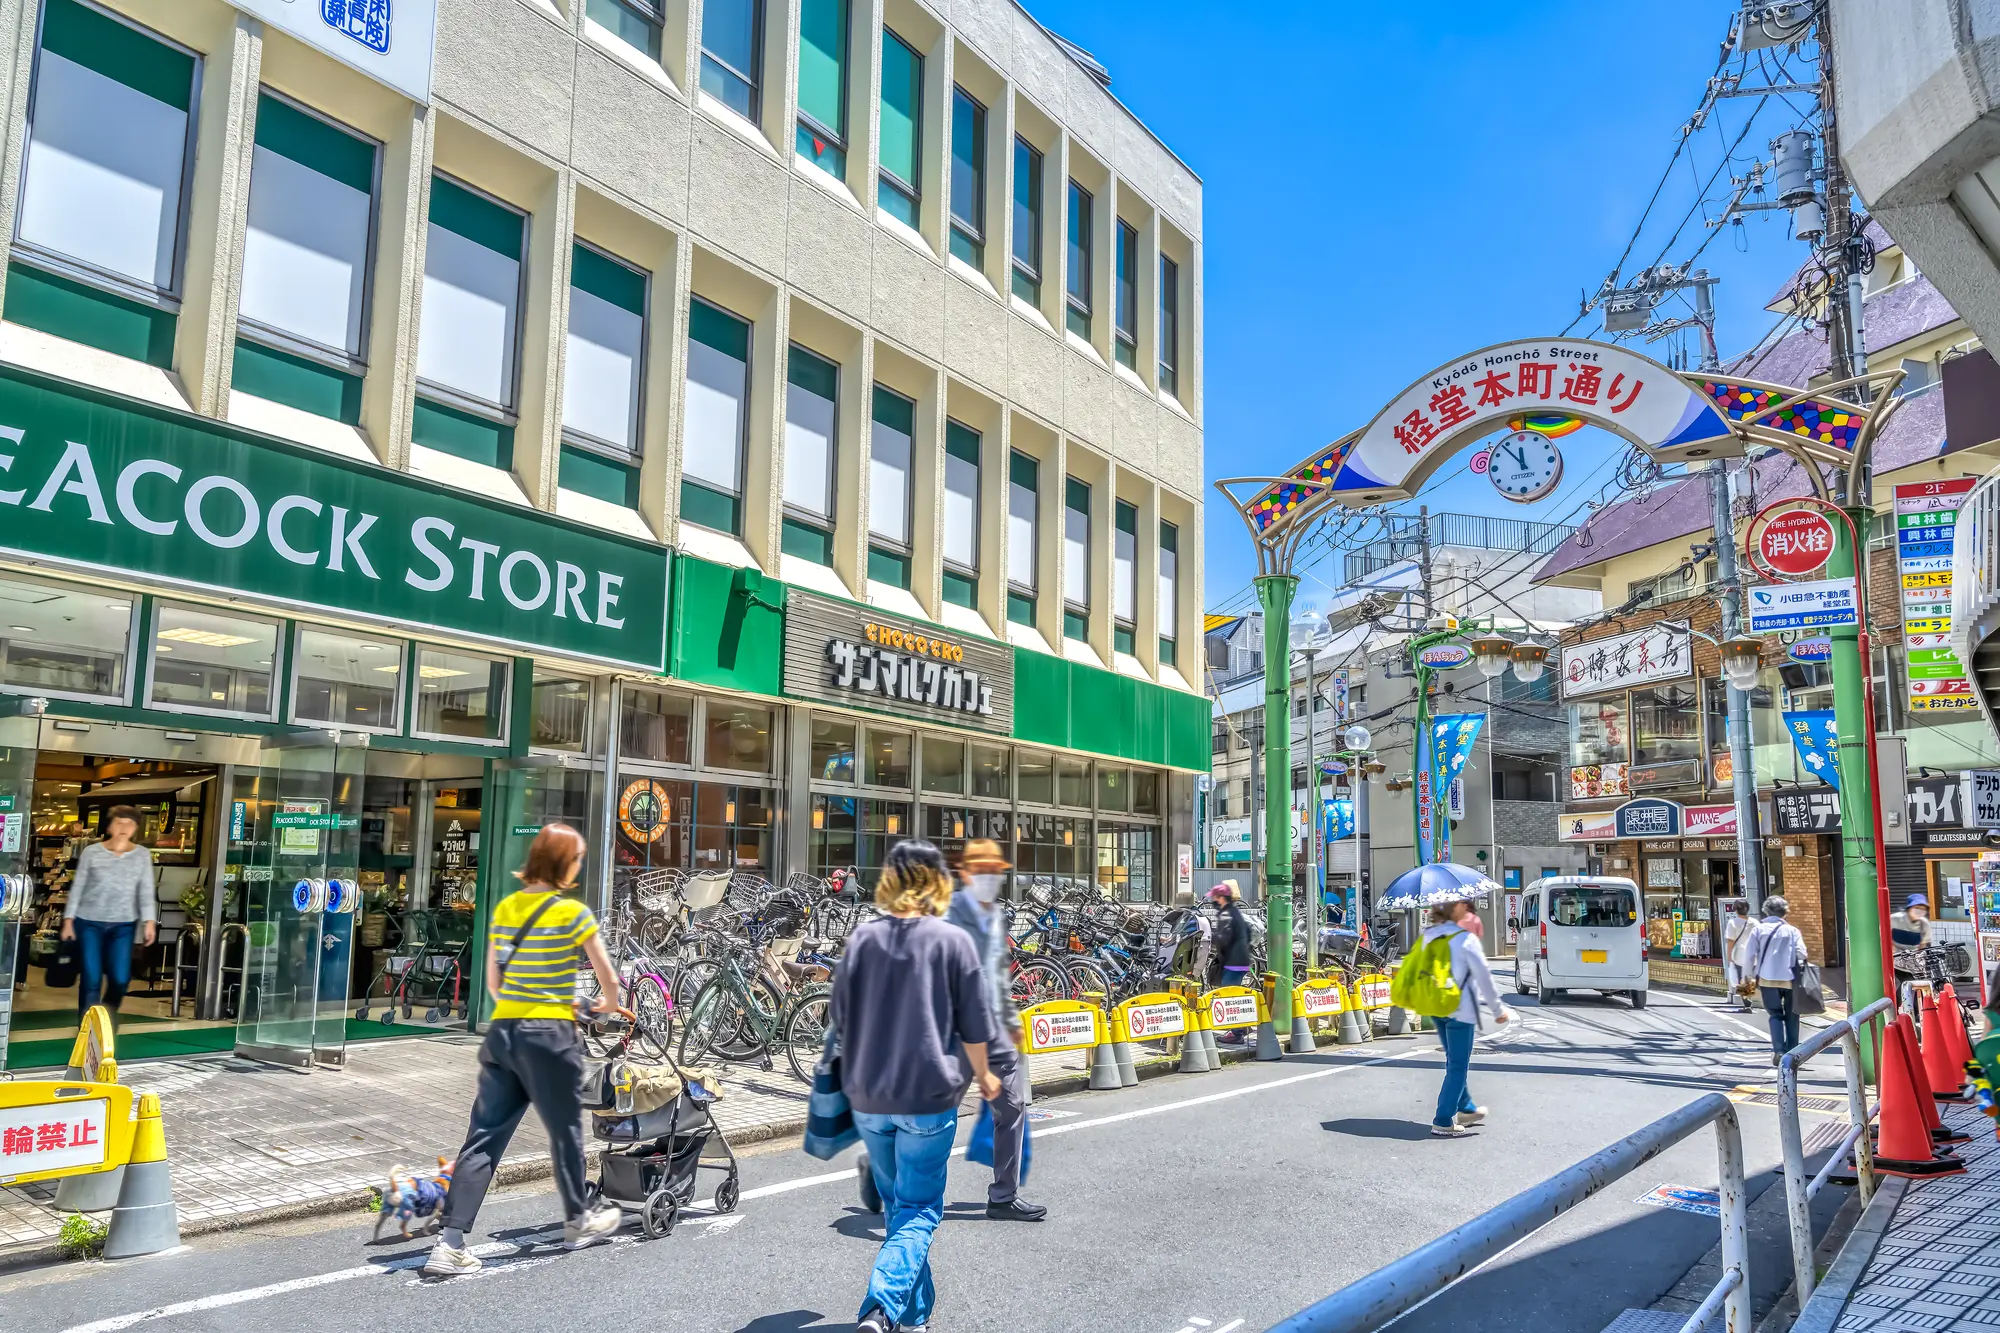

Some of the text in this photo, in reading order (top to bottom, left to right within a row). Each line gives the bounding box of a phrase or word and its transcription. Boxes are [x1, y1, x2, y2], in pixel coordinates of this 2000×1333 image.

[1432, 347, 1600, 389] Kyōdō Honchō Street
[1394, 362, 1645, 455] 経堂本町通り
[1511, 471, 1536, 481] CITIZEN
[1925, 483, 1946, 495] 2F
[1771, 516, 1819, 529] FIRE HYDRANT
[1766, 526, 1828, 557] 消火栓
[404, 515, 626, 631] STORE
[1780, 589, 1850, 603] 小田急不動産
[1823, 598, 1851, 609] 経堂店
[865, 623, 963, 662] CHOCO CRO
[1424, 651, 1464, 663] ほんちょう
[831, 639, 993, 715] サンマルクカフェ
[1929, 697, 1978, 708] おたから
[1456, 722, 1474, 747] 経堂
[1793, 721, 1815, 748] 経堂
[1976, 775, 2000, 791] デリカ
[1419, 771, 1430, 841] 経堂本町通り
[1907, 785, 1955, 824] カイ
[1986, 792, 1993, 803] の
[1691, 812, 1719, 825] WINE
[1787, 796, 1800, 828] お惣菜
[1798, 796, 1809, 828] スタンド
[1572, 819, 1583, 834] 酒
[1645, 841, 1658, 849] WINE
[1662, 841, 1675, 849] GIFT
[1929, 834, 1967, 842] DELICATESSEN
[2, 1119, 98, 1156] 輪禁止
